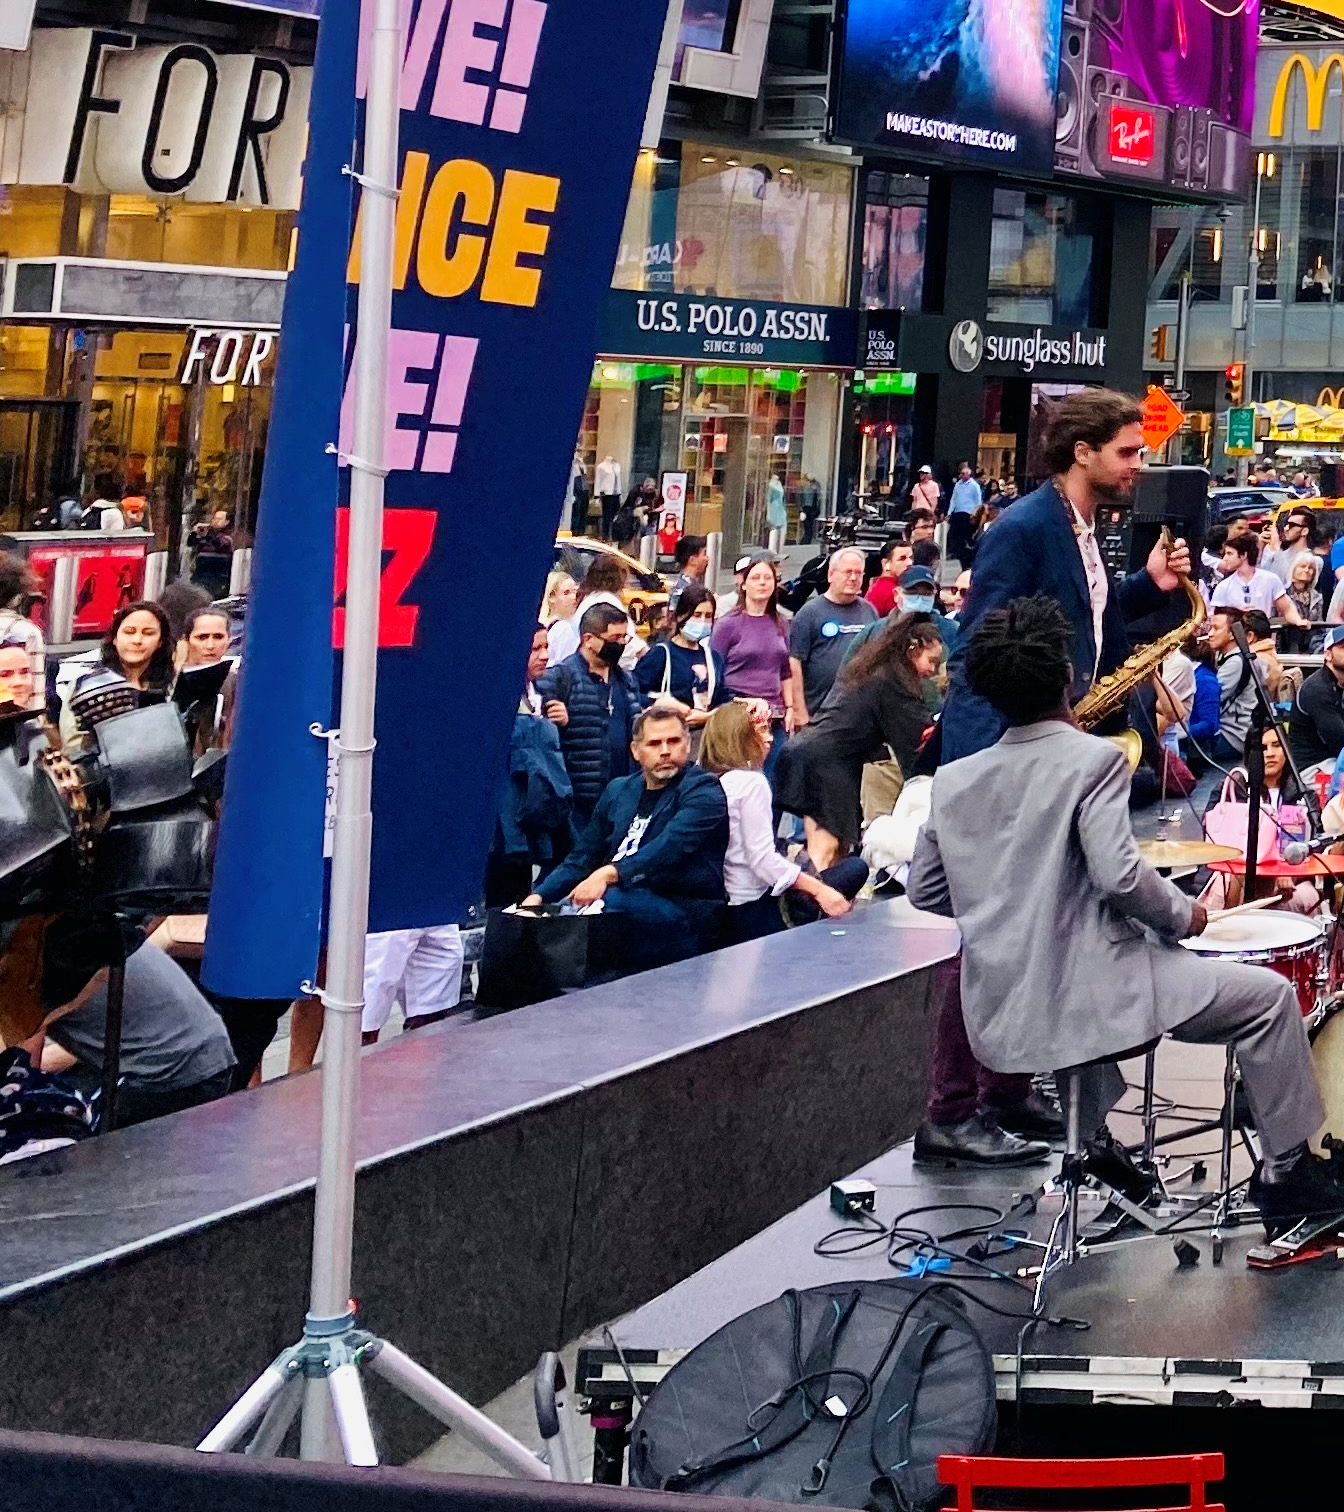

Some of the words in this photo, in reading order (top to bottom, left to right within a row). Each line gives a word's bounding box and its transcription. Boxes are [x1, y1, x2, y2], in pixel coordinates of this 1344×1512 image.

[636, 299, 681, 333] U.S.
[688, 303, 757, 337] POLO
[760, 309, 831, 342] ASSN.
[868, 331, 886, 340] U.S.
[703, 340, 736, 354] SINCE
[739, 342, 764, 355] 1890
[867, 340, 895, 351] POLO
[986, 328, 1070, 372] sunglass
[1073, 332, 1107, 367] hut
[181, 328, 272, 387] FOR
[866, 349, 896, 360] ASSN.
